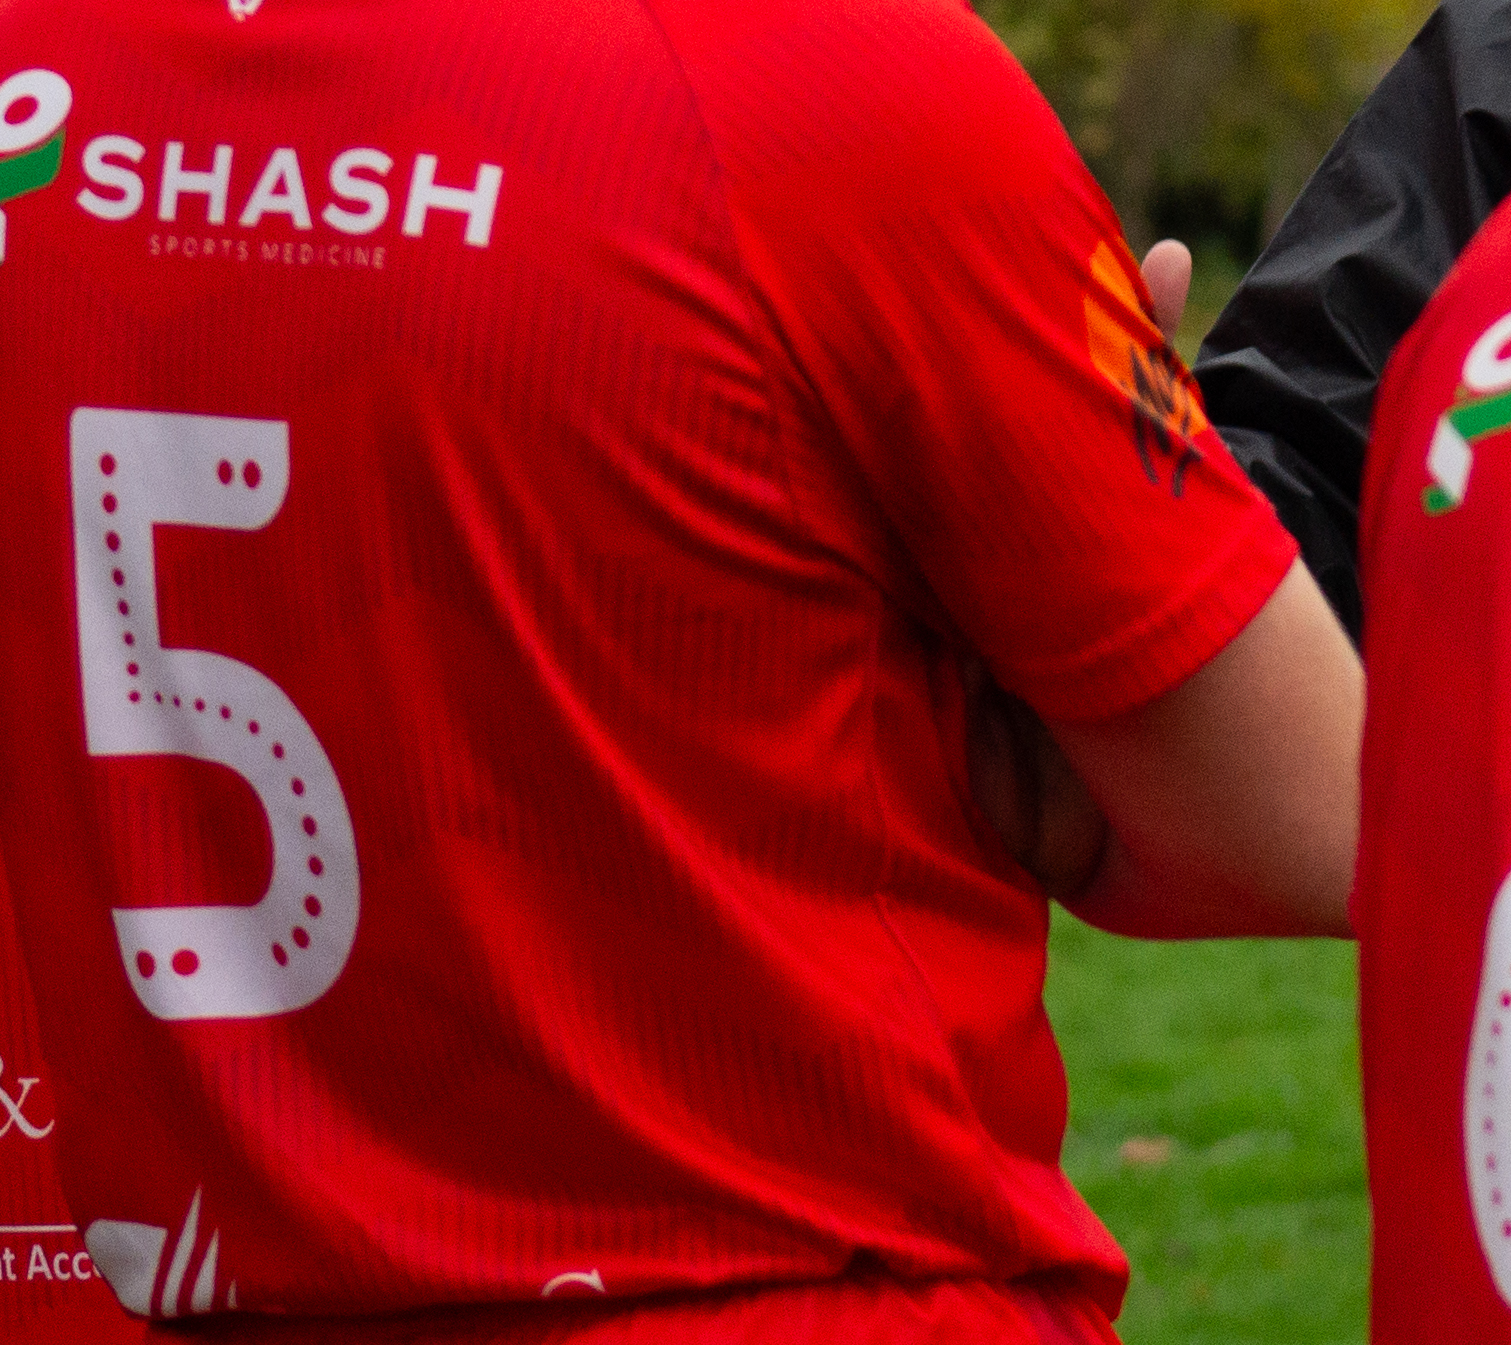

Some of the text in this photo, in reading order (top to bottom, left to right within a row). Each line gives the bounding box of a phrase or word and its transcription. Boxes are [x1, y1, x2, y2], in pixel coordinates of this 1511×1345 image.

[76, 134, 504, 248] SHASH
[148, 233, 388, 270] SPORTS MEDICINE
[69, 406, 361, 1021] 5
